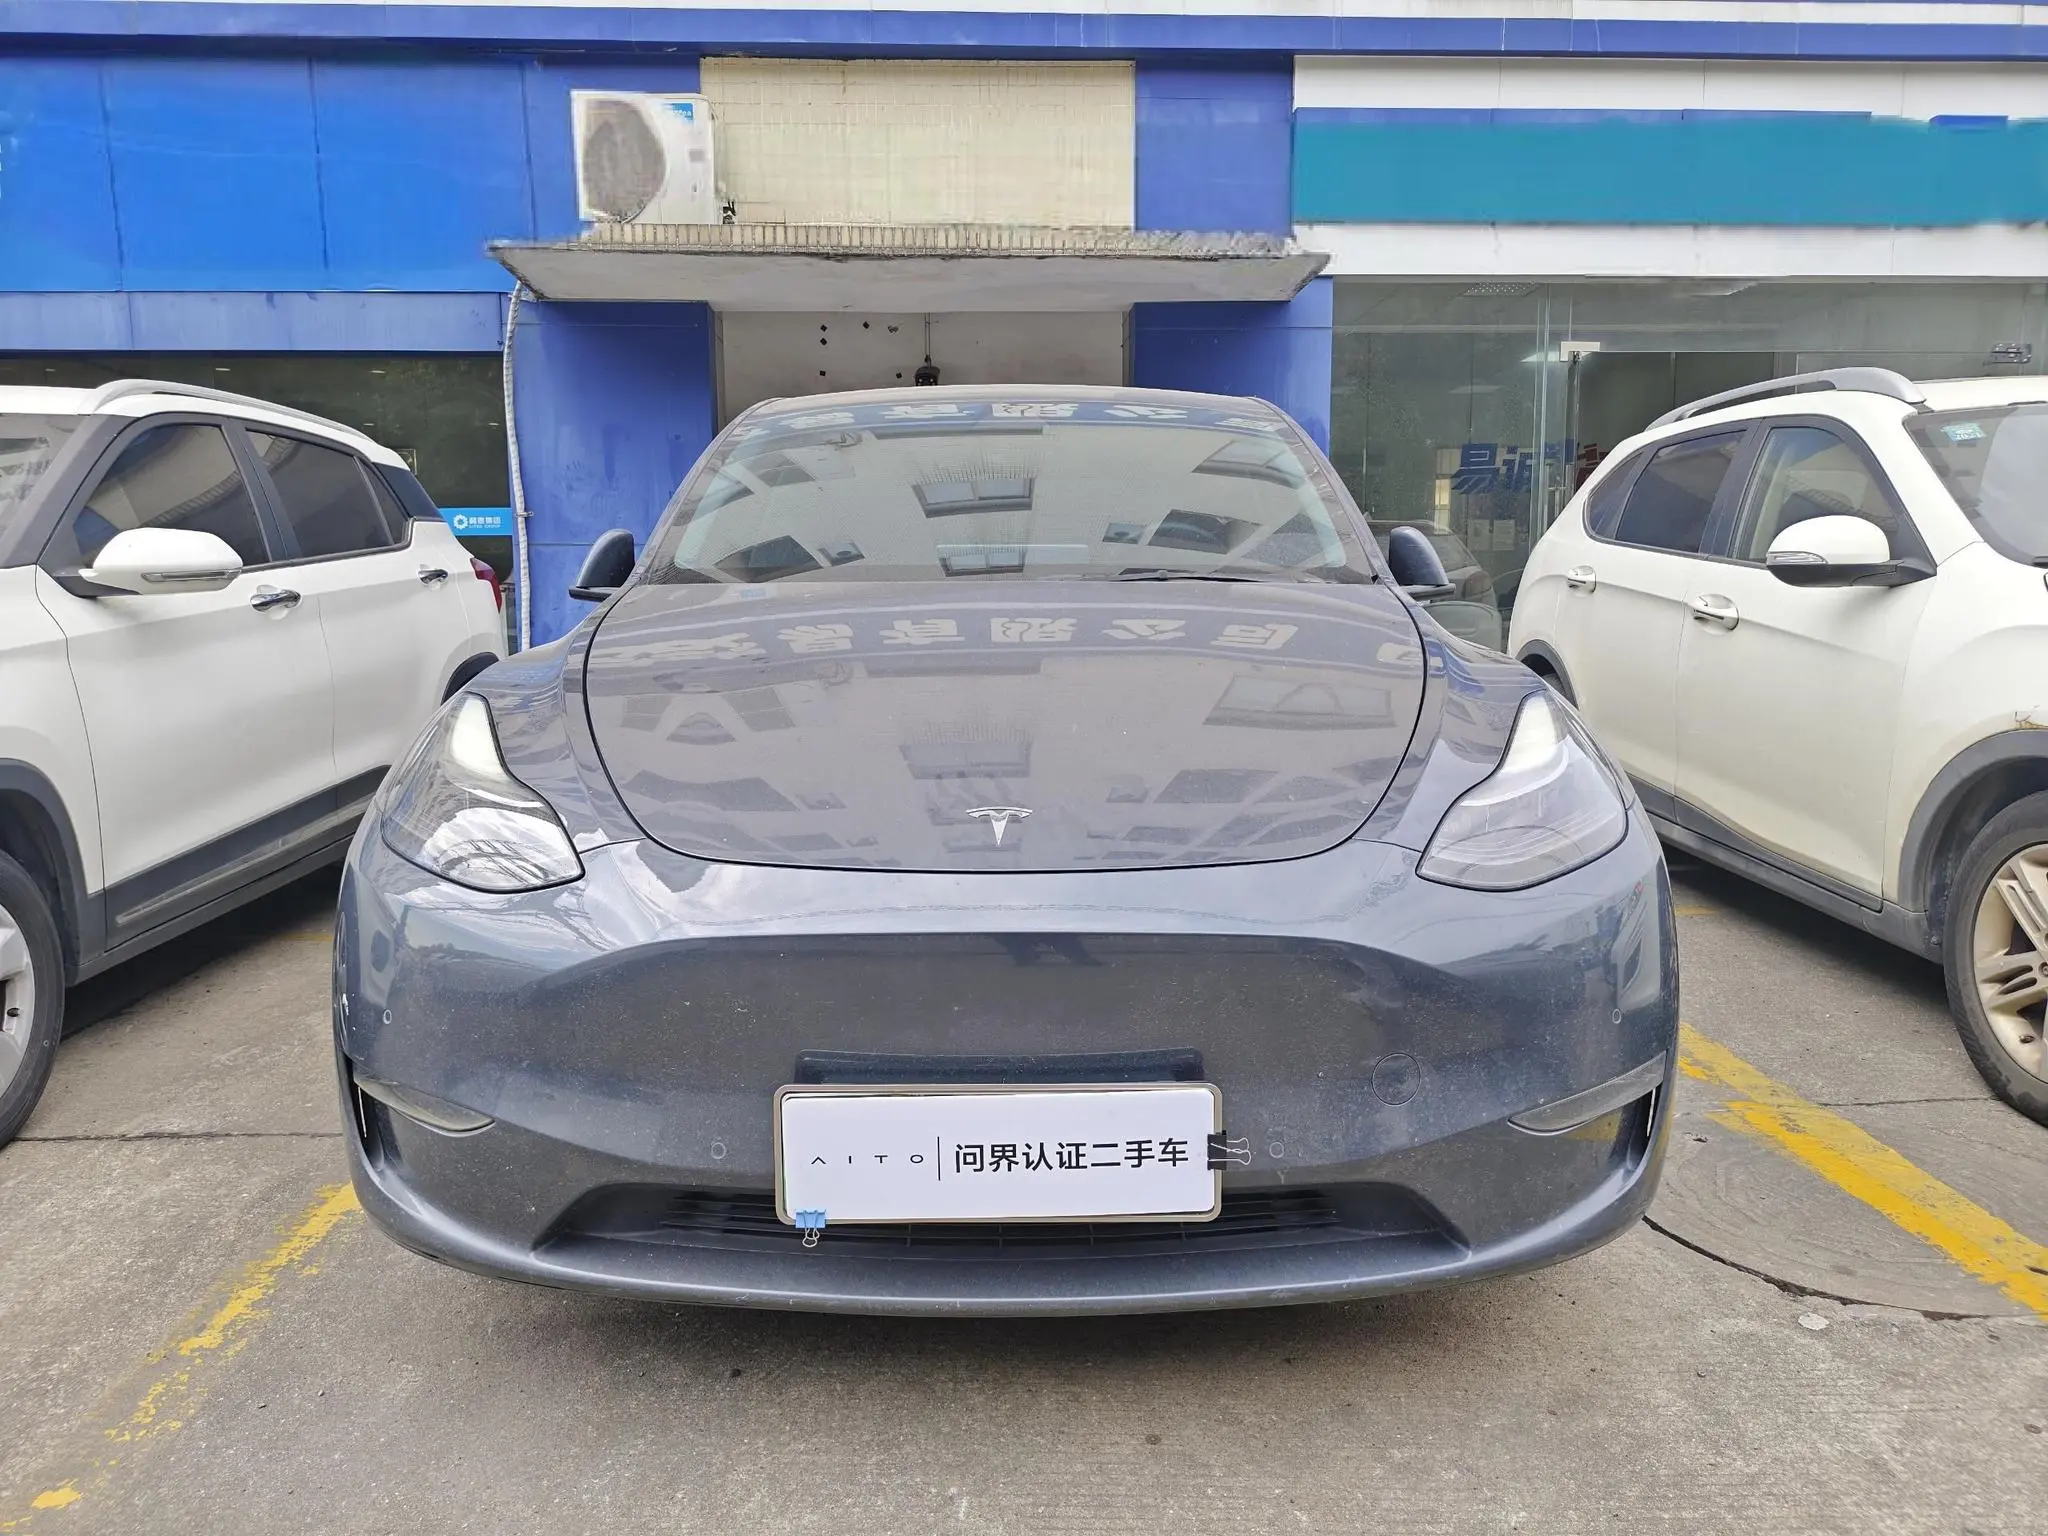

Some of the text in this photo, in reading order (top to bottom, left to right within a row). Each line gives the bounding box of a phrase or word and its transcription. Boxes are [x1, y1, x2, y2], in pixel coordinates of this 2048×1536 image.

[955, 1137, 1189, 1173] 问界认证二手车
